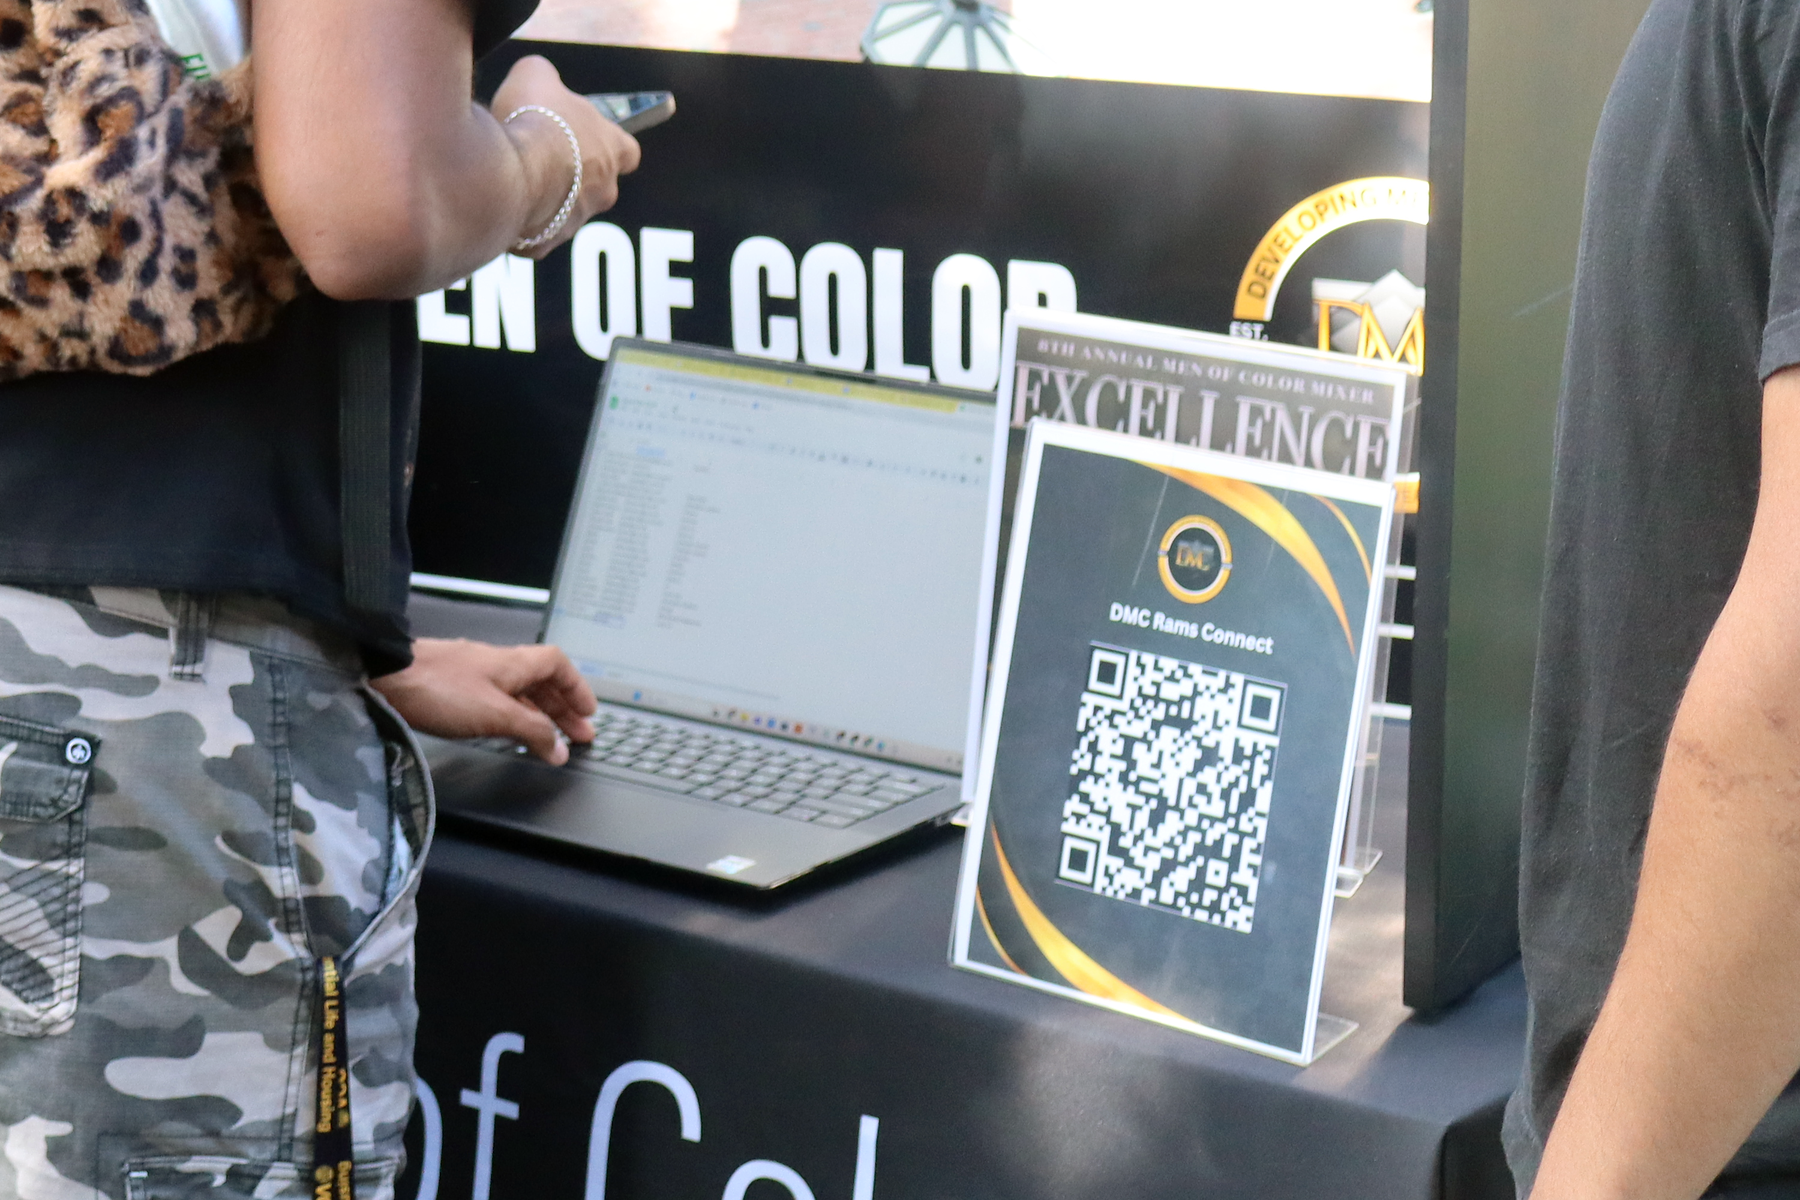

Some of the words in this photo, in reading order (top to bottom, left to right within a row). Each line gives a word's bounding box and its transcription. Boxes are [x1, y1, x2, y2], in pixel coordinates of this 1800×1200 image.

[1248, 187, 1377, 300] DEVELOPING
[571, 222, 694, 360] OF
[1229, 321, 1269, 341] EST.
[1207, 364, 1235, 382] OF
[1238, 369, 1306, 394] COLOR
[1109, 602, 1151, 628] DMC
[1152, 611, 1199, 639] Rams
[1201, 622, 1275, 655] Connect
[323, 1000, 339, 1030] Life
[322, 1033, 337, 1063] and
[317, 1066, 337, 1133] Housing
